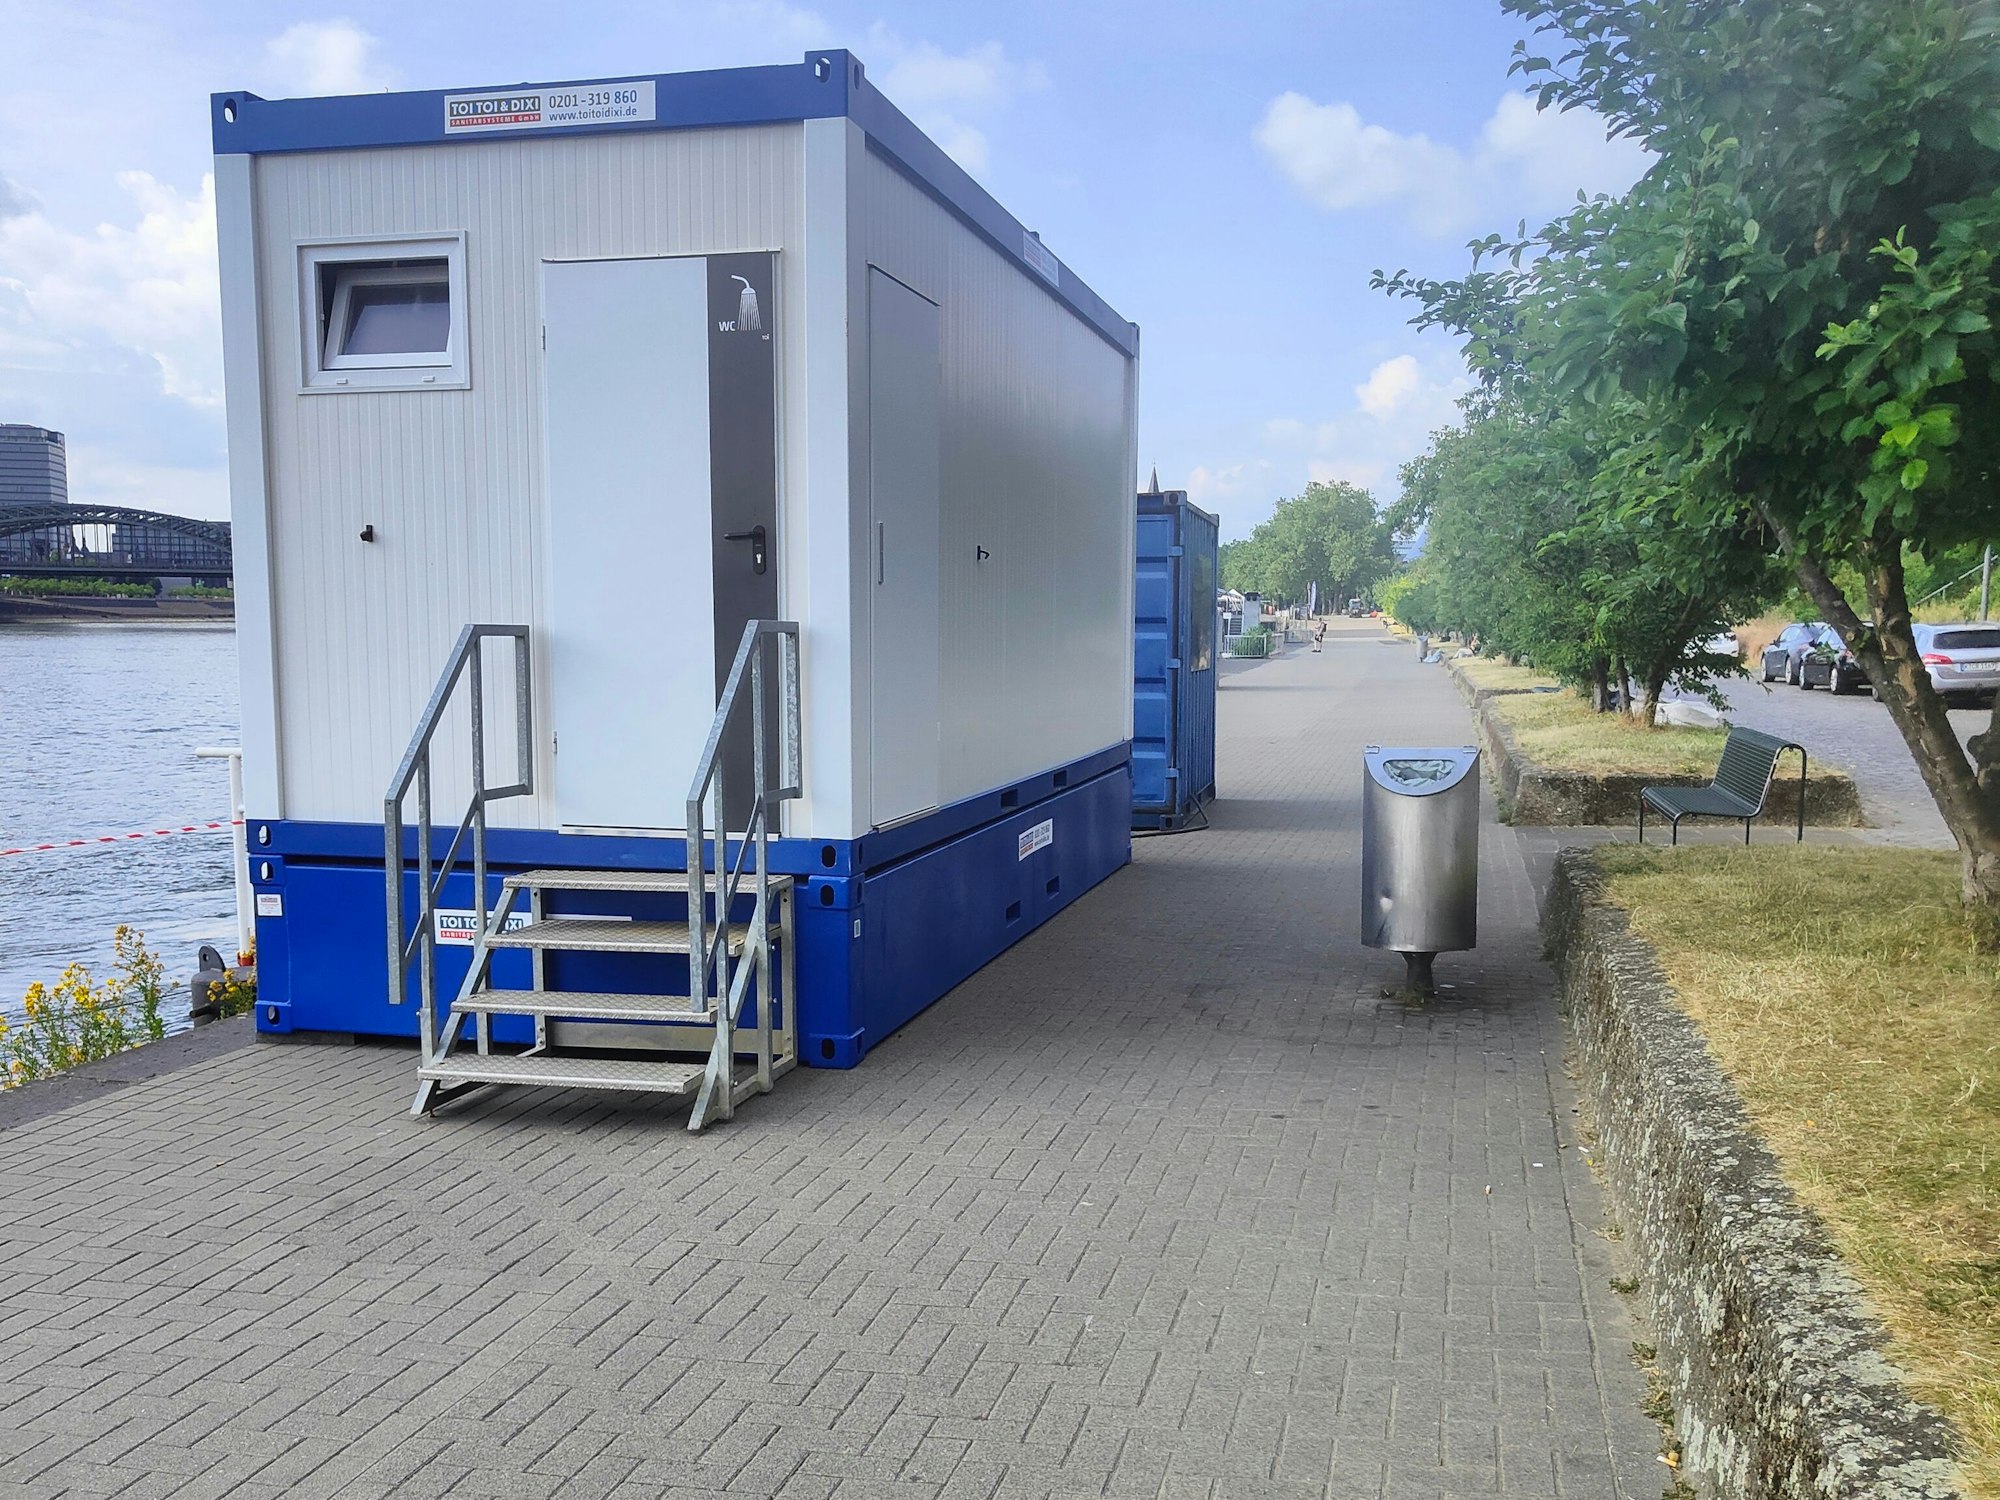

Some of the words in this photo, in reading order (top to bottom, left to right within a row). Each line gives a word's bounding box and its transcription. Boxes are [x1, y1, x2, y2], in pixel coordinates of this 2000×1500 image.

[614, 90, 637, 104] 860
[451, 103, 474, 115] TOI
[476, 101, 498, 113] TOI
[500, 100, 509, 112] &
[511, 98, 539, 111] DIXI
[549, 105, 637, 121] www.toitoidixi.de
[718, 321, 736, 332] WC
[441, 916, 462, 928] TOI
[464, 917, 478, 929] TO
[504, 919, 523, 931] IXI
